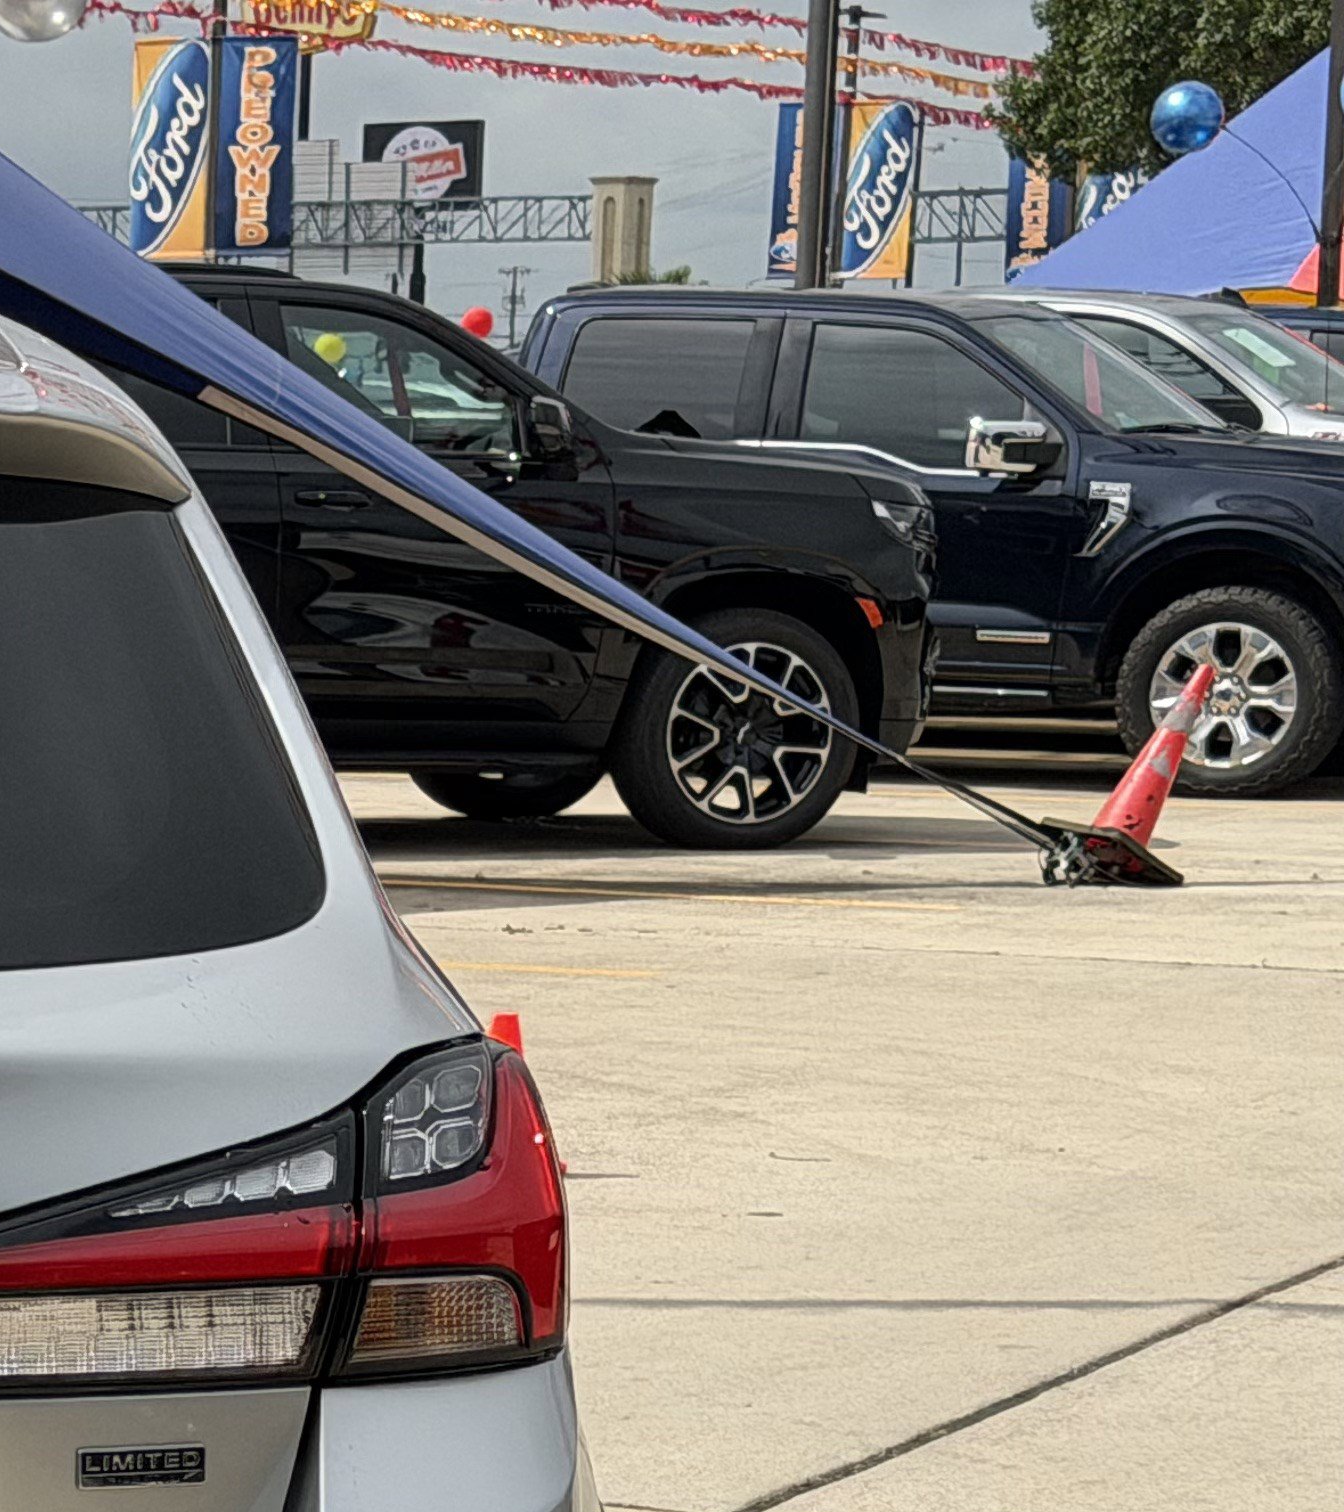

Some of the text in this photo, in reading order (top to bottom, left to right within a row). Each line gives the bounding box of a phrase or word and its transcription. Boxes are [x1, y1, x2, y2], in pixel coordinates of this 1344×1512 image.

[129, 71, 206, 224] Ford
[843, 128, 911, 251] Ford
[85, 1451, 201, 1472] LIMITED
